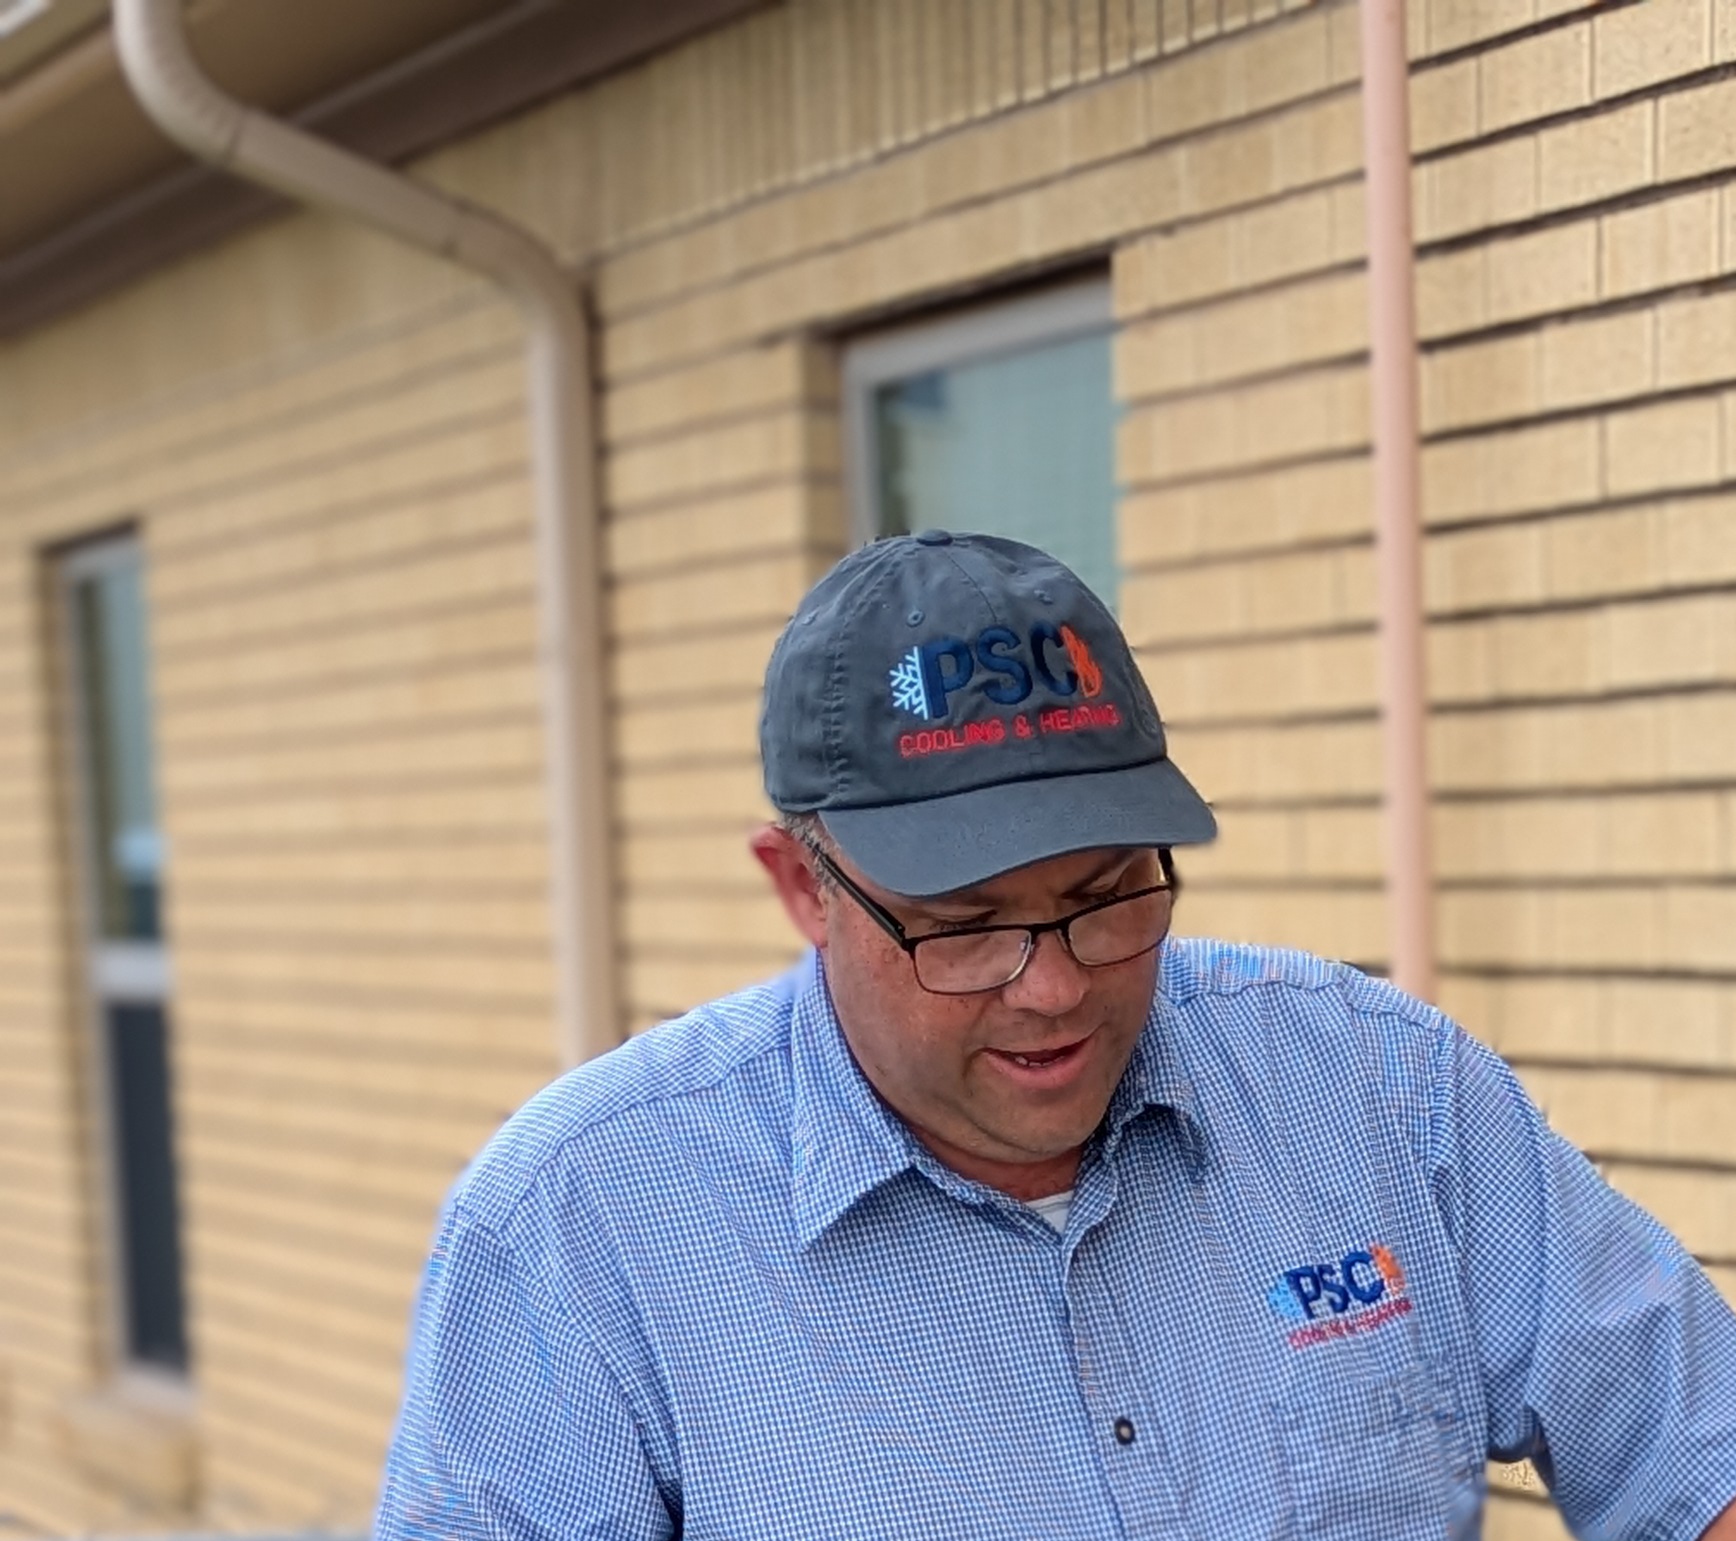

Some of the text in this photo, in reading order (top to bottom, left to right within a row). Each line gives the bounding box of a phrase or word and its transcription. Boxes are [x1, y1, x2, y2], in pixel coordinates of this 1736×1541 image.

[921, 621, 1078, 719] PSC
[899, 718, 1004, 758] COOLING
[1013, 714, 1032, 740] &
[1284, 1251, 1384, 1320] PSC
